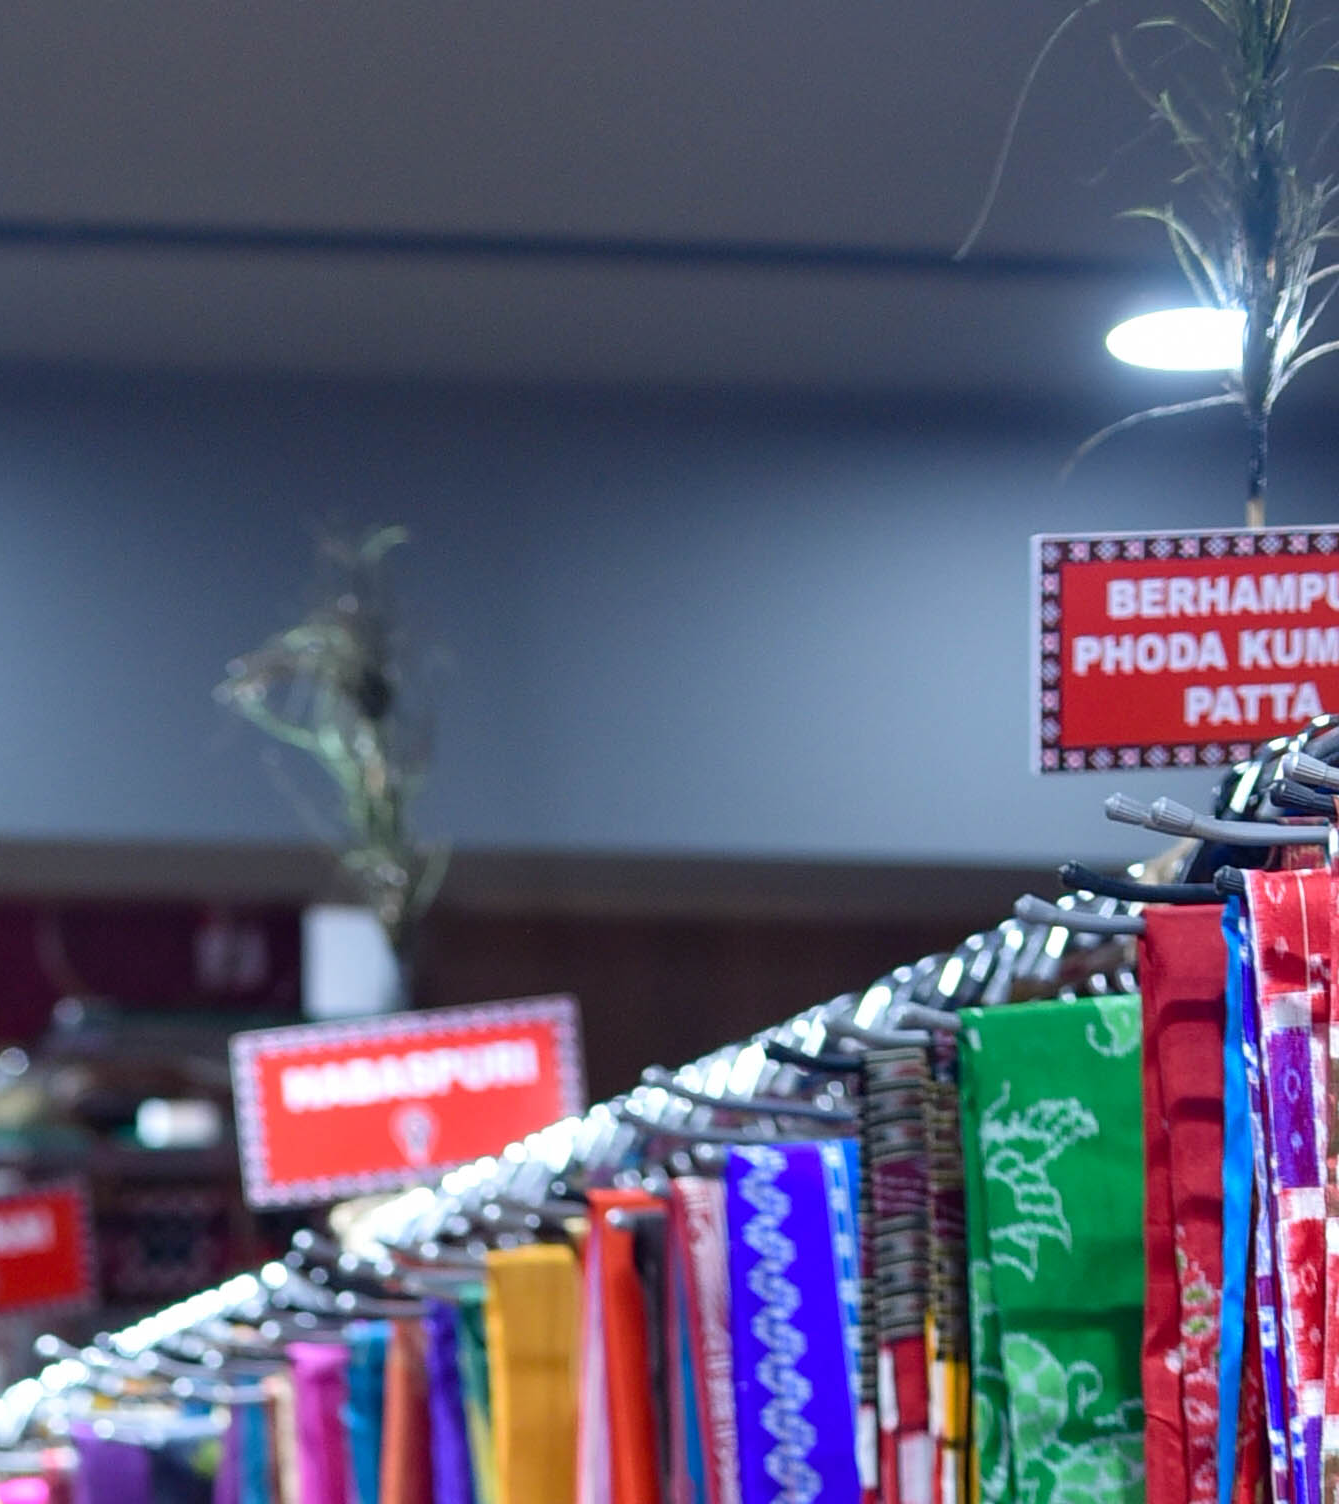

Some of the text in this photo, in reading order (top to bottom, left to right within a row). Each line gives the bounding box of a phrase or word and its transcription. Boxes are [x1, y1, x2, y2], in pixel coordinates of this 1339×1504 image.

[1072, 626, 1339, 677] PHODA KUM
[1183, 681, 1324, 728] PATTA
